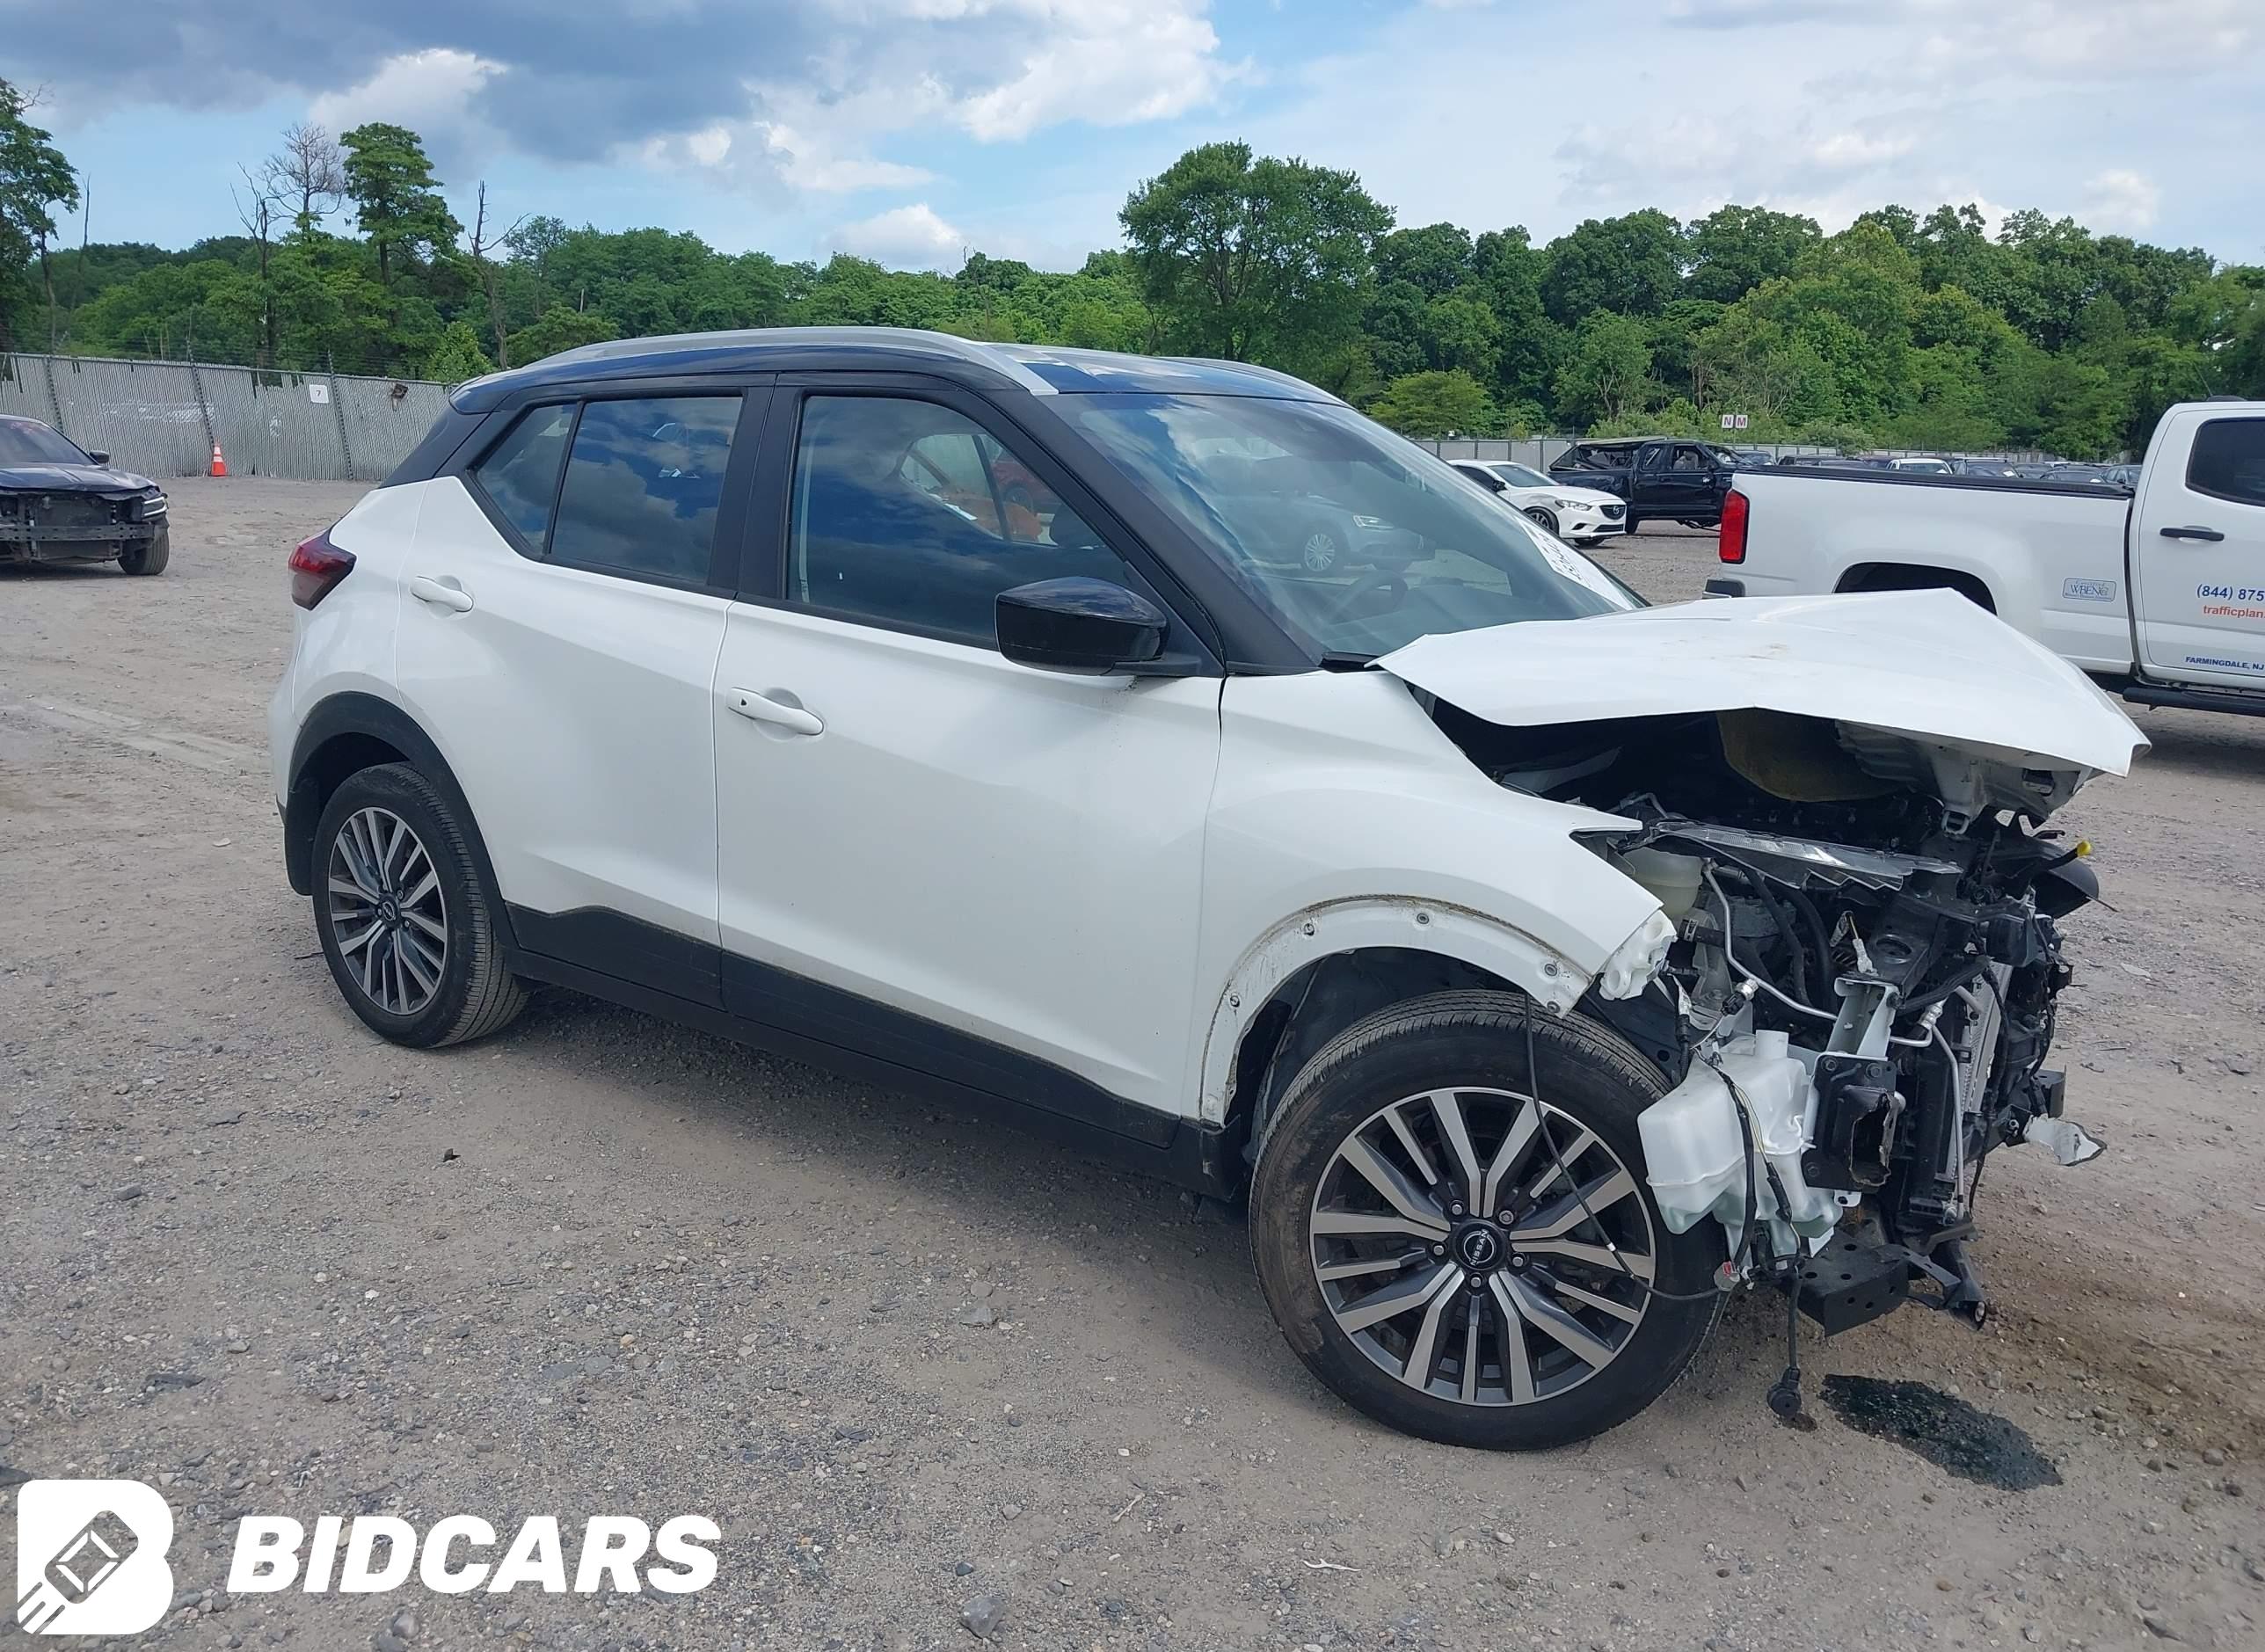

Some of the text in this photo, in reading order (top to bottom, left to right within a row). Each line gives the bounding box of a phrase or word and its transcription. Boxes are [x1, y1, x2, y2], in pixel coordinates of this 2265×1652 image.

[1724, 417, 1731, 426] N
[1737, 418, 1745, 426] M
[2196, 584, 2265, 602] (844) 875
[2185, 657, 2250, 670] FARMINGDALE,
[1470, 1228, 1489, 1266] NISSAN
